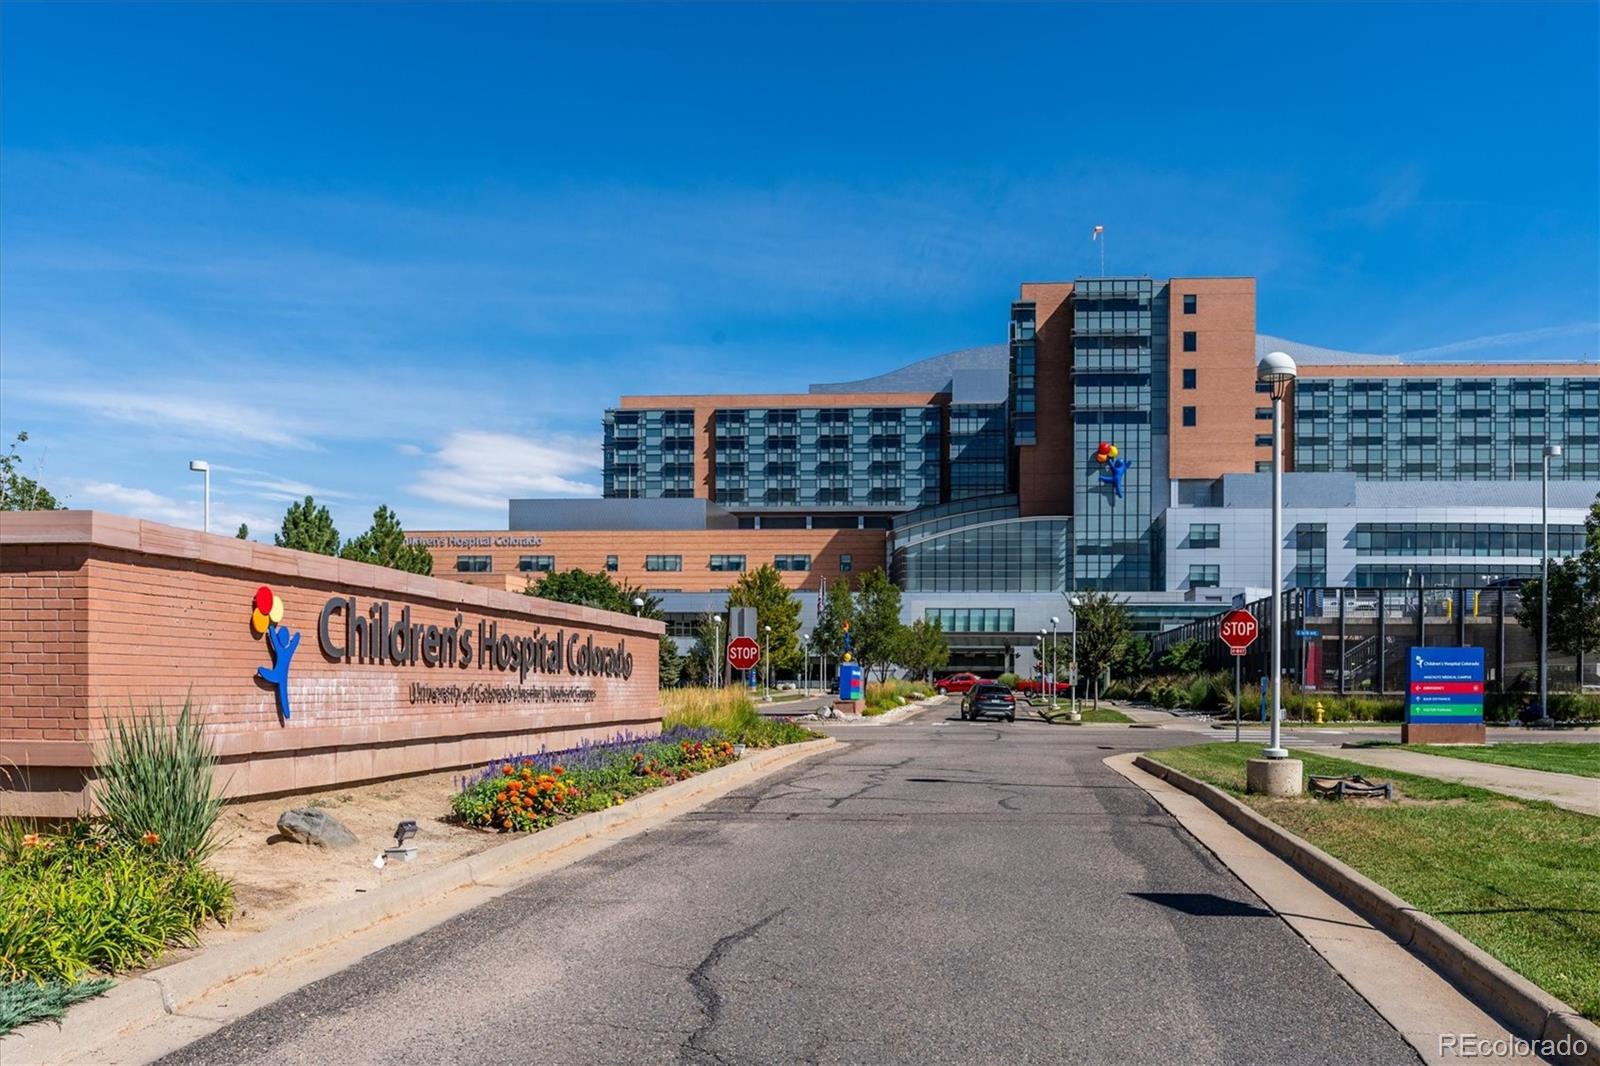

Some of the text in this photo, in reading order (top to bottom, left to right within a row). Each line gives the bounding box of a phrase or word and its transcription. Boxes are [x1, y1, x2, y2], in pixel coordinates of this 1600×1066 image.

[447, 536, 492, 549] Hospital
[495, 536, 543, 548] Colorado
[1223, 621, 1255, 636] STOP
[318, 596, 633, 683] Children's Hospital Colorado
[729, 647, 757, 659] STOP
[409, 682, 461, 707] University
[462, 684, 474, 704] of
[474, 683, 514, 704] Colorado
